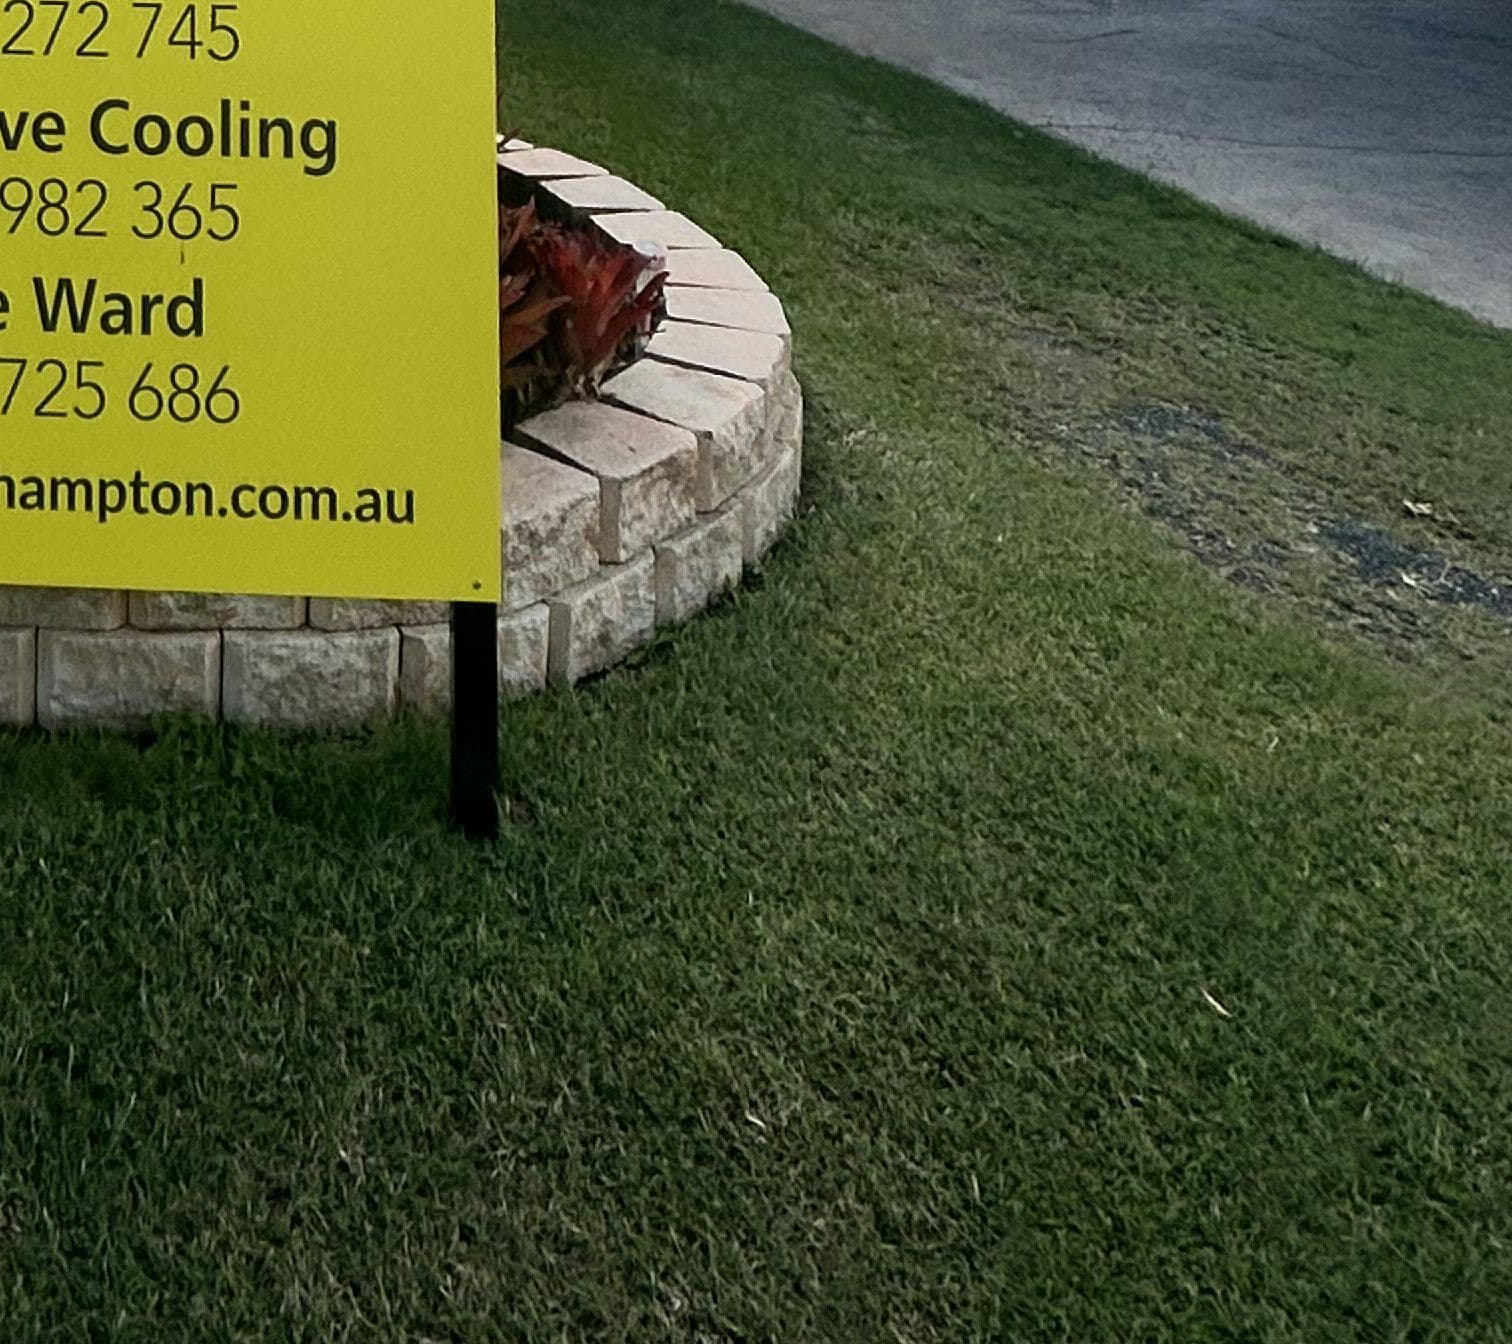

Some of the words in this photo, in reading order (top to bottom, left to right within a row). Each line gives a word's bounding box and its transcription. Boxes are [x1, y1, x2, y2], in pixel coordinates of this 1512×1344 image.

[131, 2, 240, 62] 745
[89, 98, 337, 177] Cooling
[131, 180, 240, 242] 365
[32, 276, 204, 338] Ward
[128, 362, 240, 424] 686
